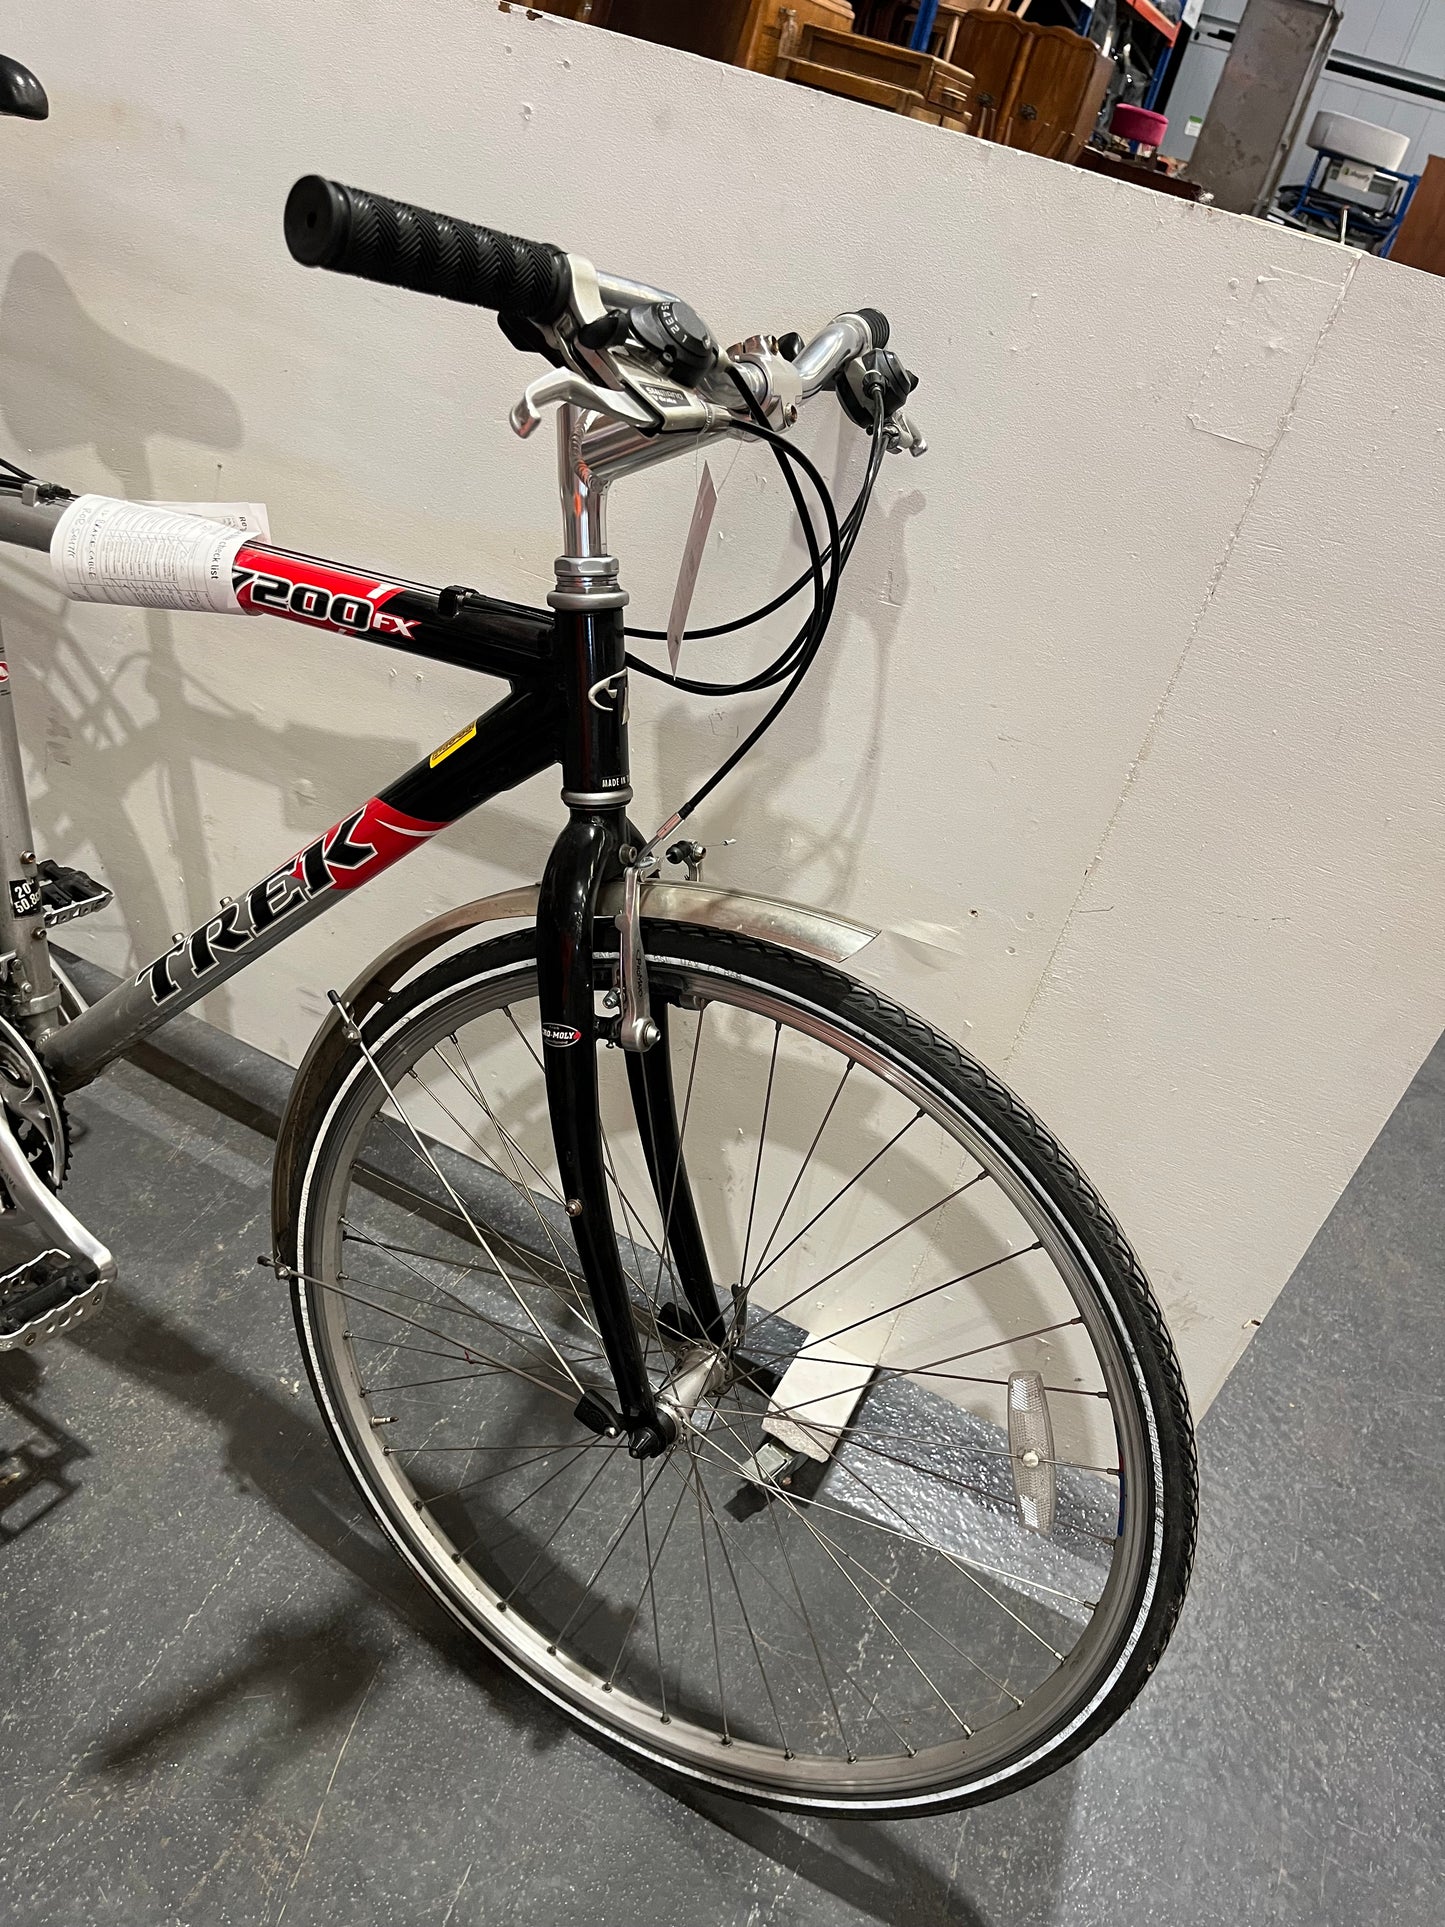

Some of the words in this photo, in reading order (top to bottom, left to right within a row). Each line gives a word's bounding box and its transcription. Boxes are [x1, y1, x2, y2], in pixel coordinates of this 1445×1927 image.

[665, 317, 674, 325] 3
[670, 324, 680, 334] 2
[682, 334, 688, 343] 1
[210, 564, 219, 579] list
[372, 611, 422, 640] FX
[602, 777, 619, 788] MADE
[135, 803, 378, 1005] TREK
